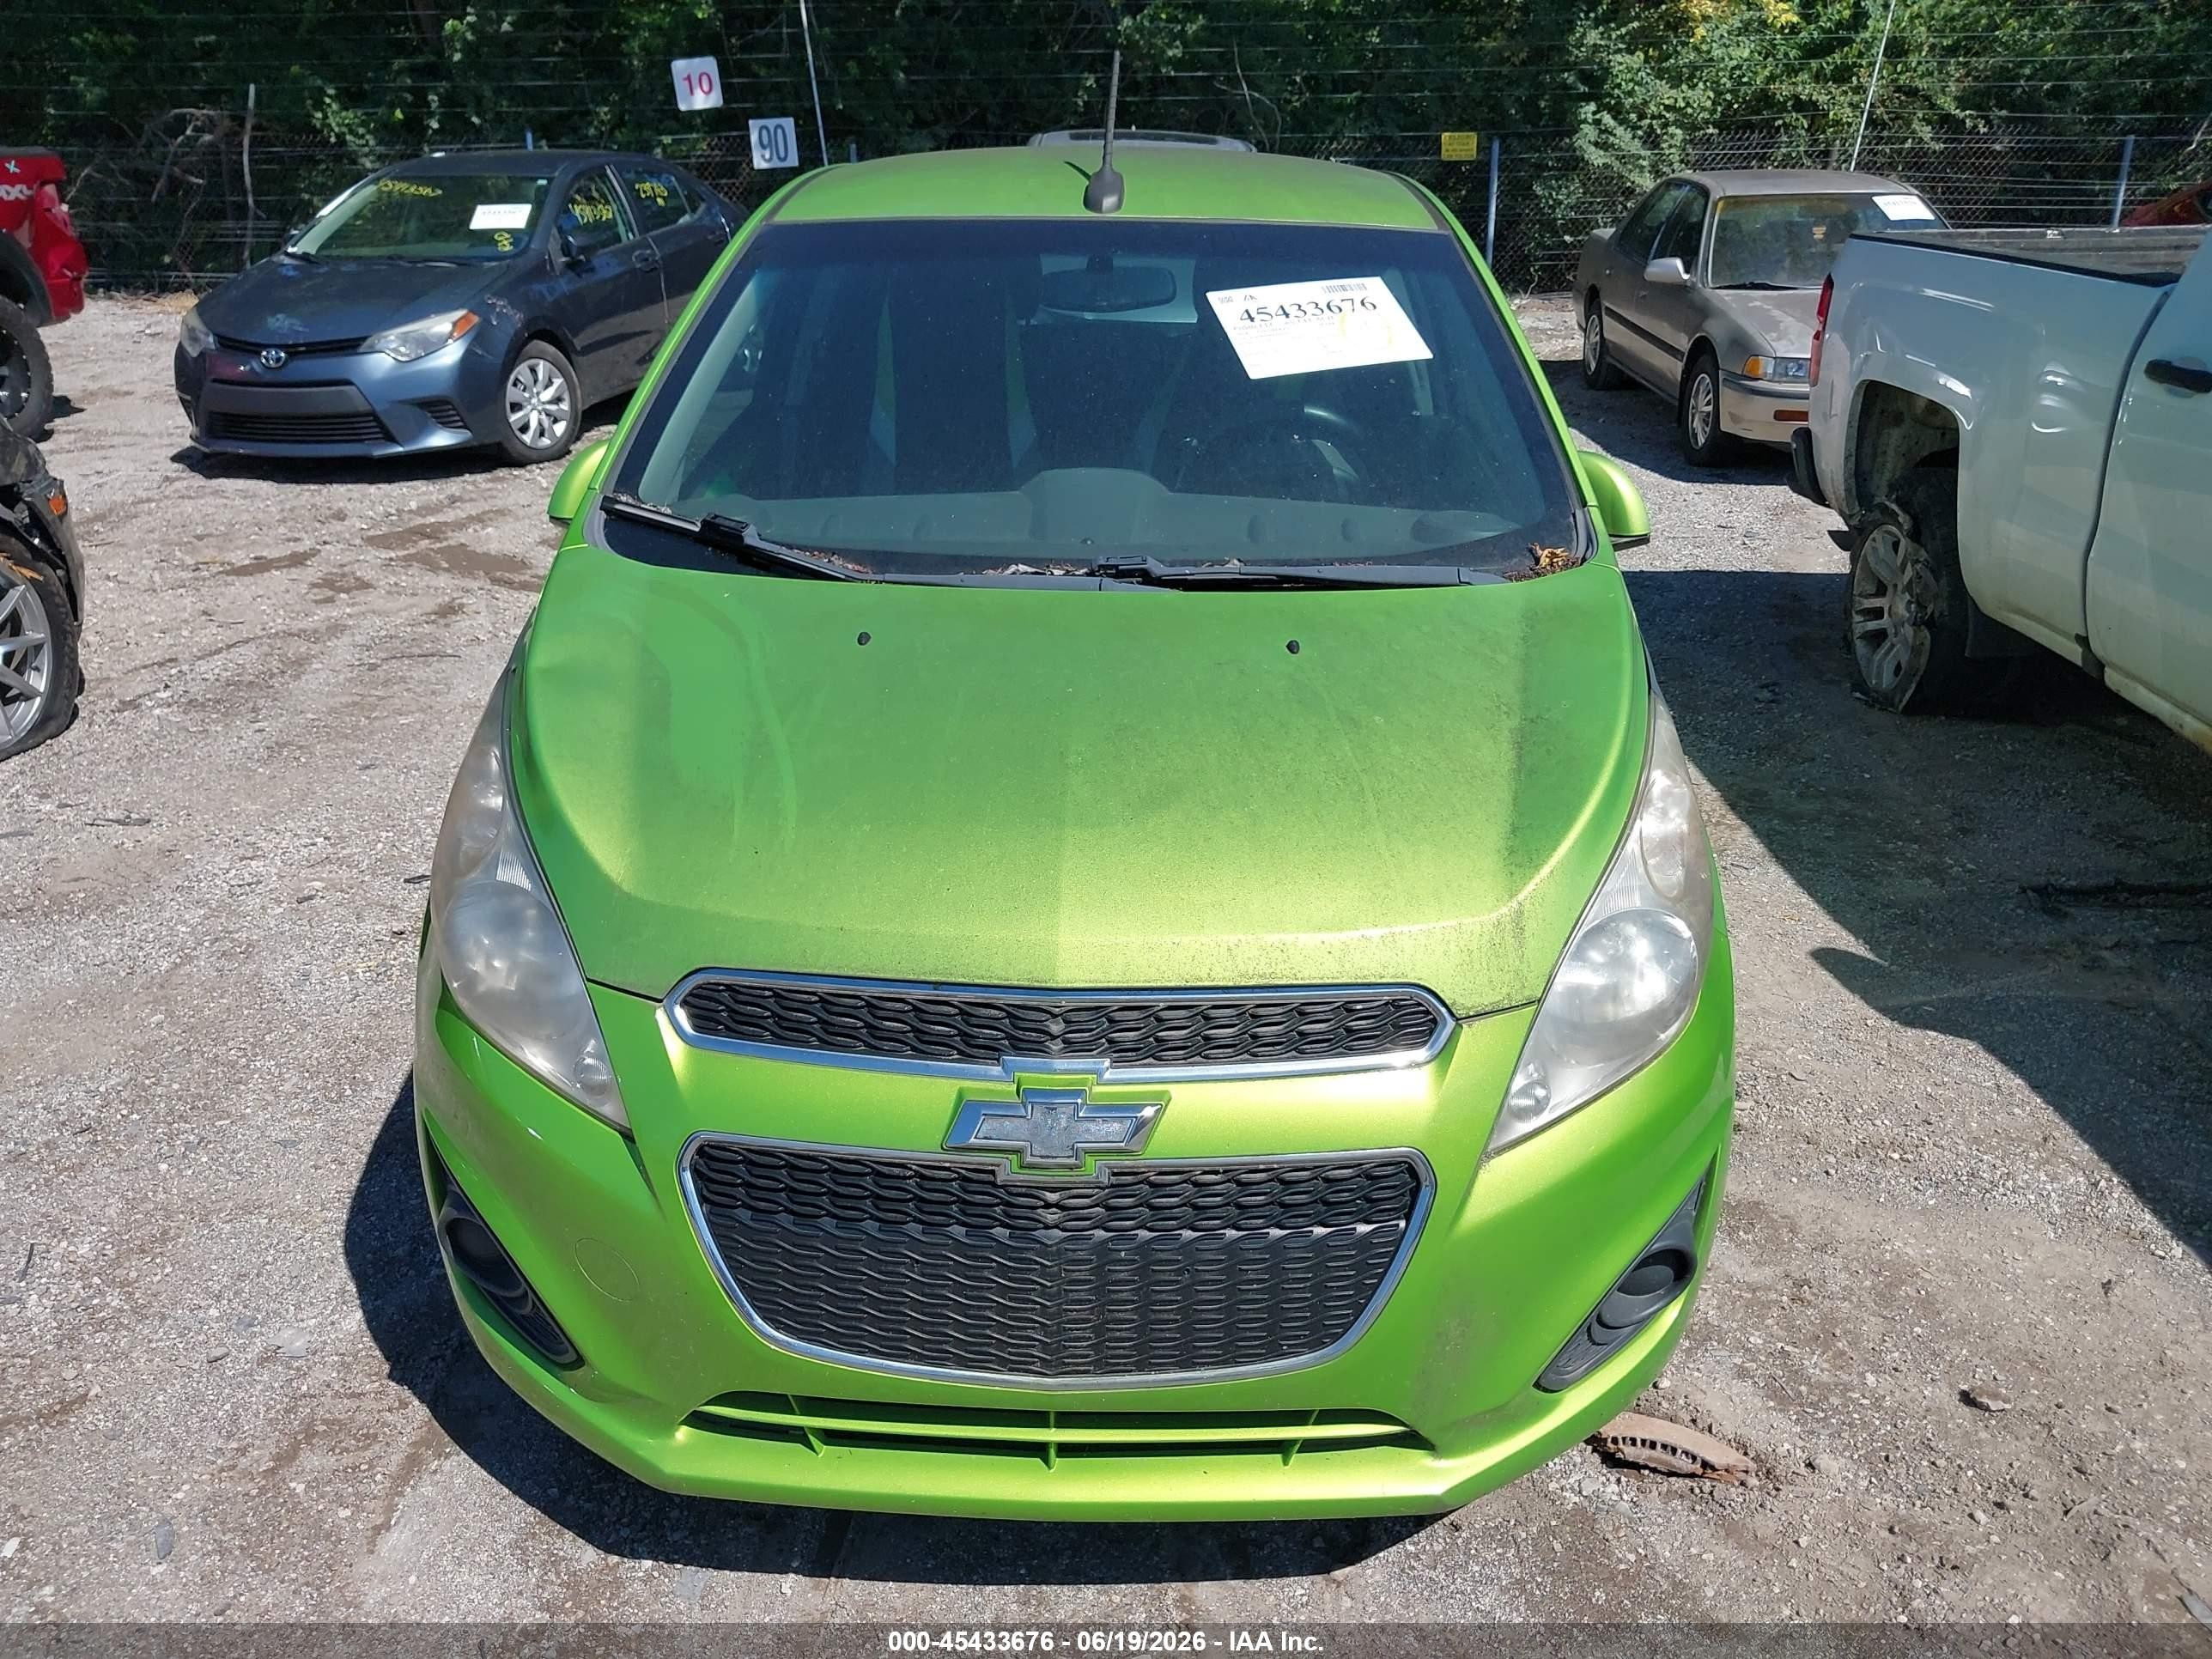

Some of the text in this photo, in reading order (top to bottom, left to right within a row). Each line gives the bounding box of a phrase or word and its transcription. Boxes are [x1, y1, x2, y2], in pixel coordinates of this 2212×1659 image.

[683, 71, 714, 96] 10
[758, 124, 788, 163] 90
[1239, 295, 1377, 323] 45433676
